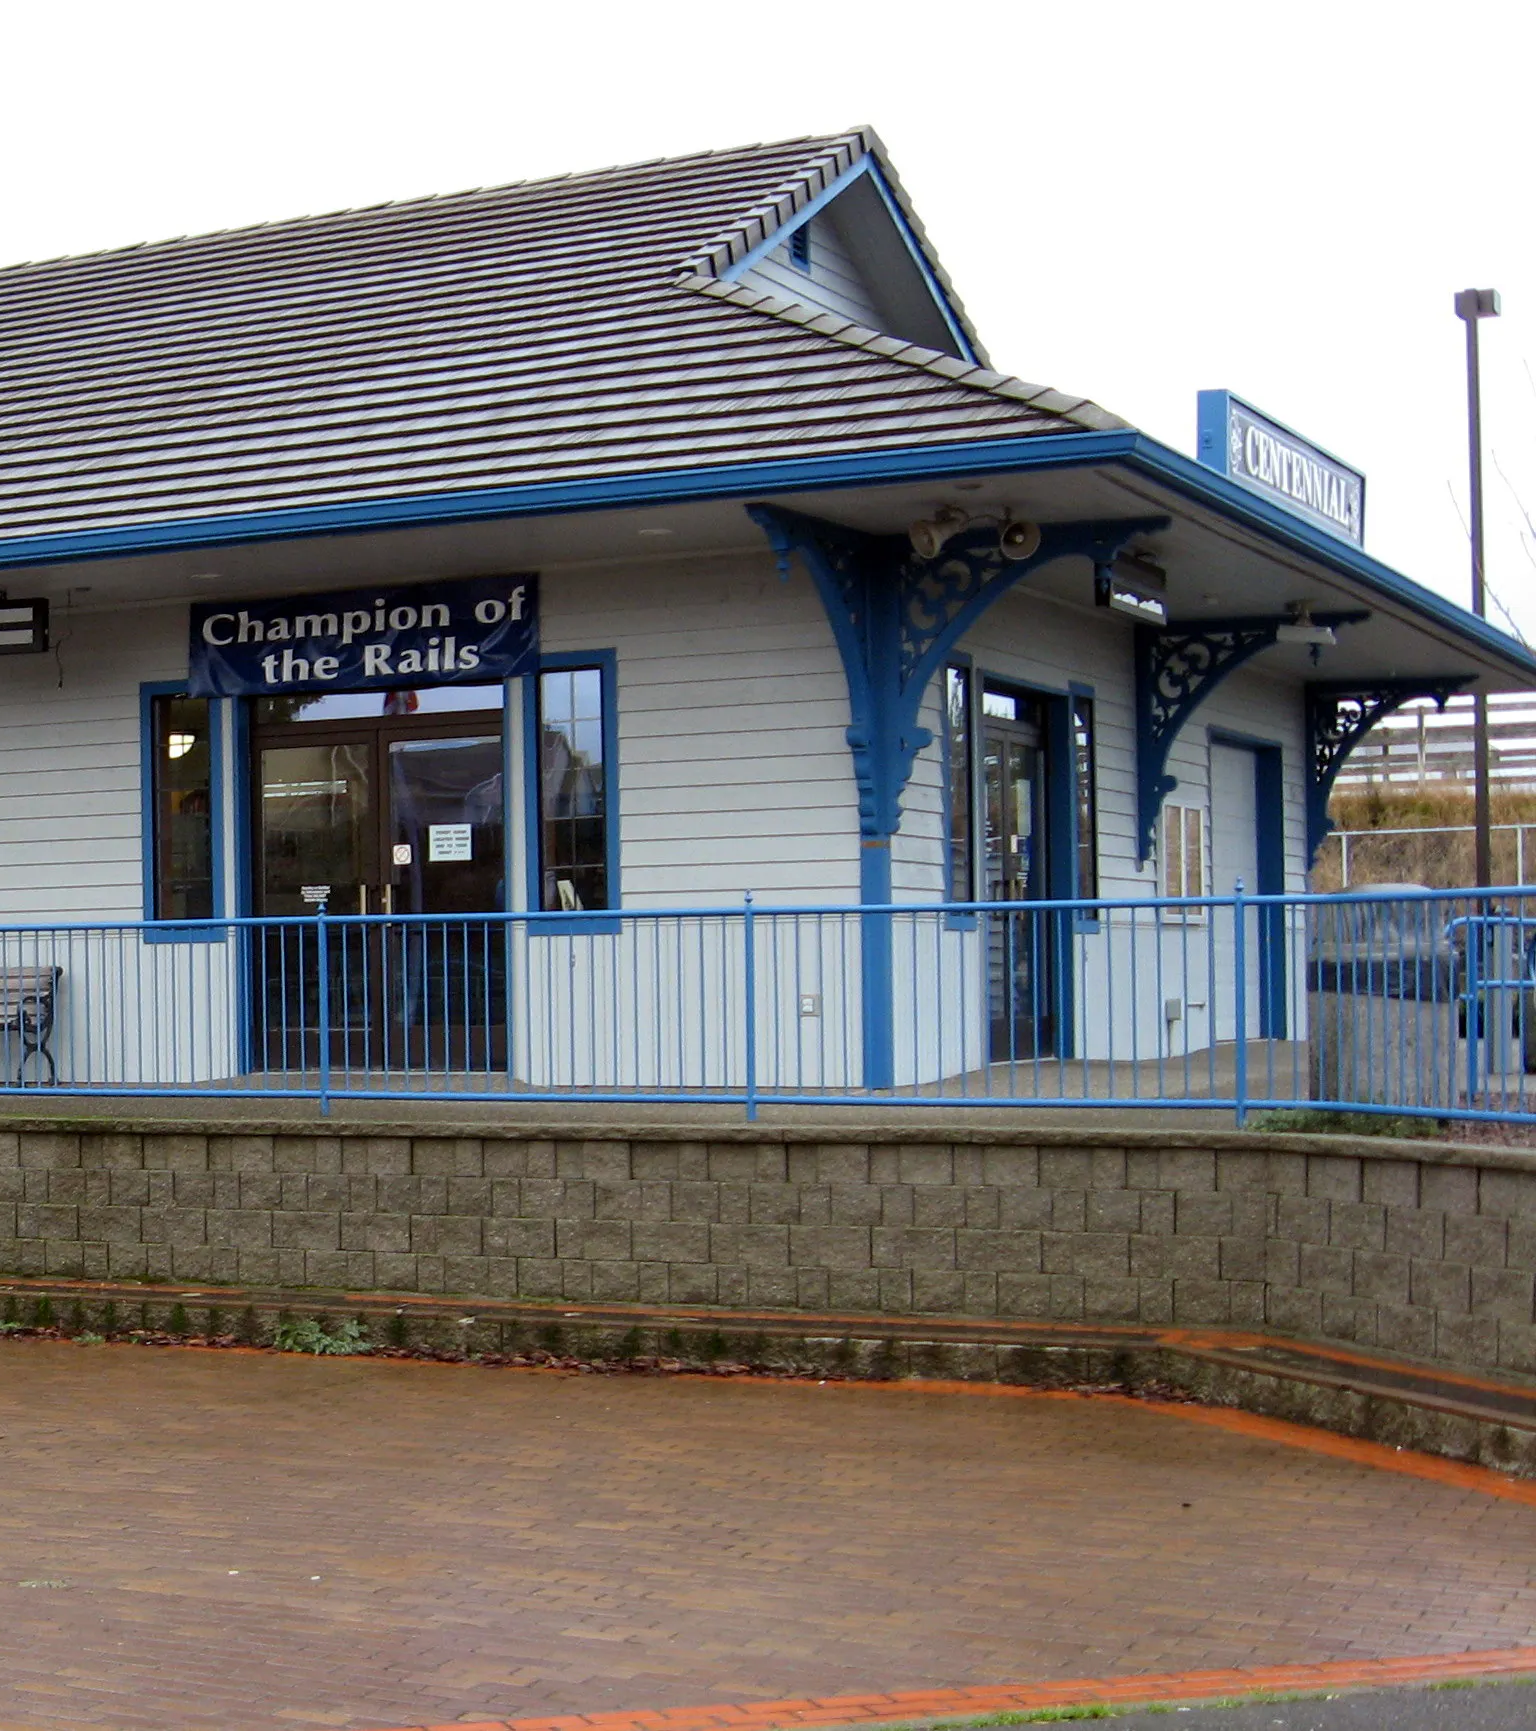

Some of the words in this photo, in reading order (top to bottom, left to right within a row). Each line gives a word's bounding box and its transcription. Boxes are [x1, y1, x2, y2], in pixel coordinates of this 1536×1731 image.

[1245, 425, 1349, 526] CENTENNIAL
[202, 598, 451, 645] Champion
[474, 585, 526, 624] of
[261, 649, 339, 684] the
[364, 636, 480, 677] Rails
